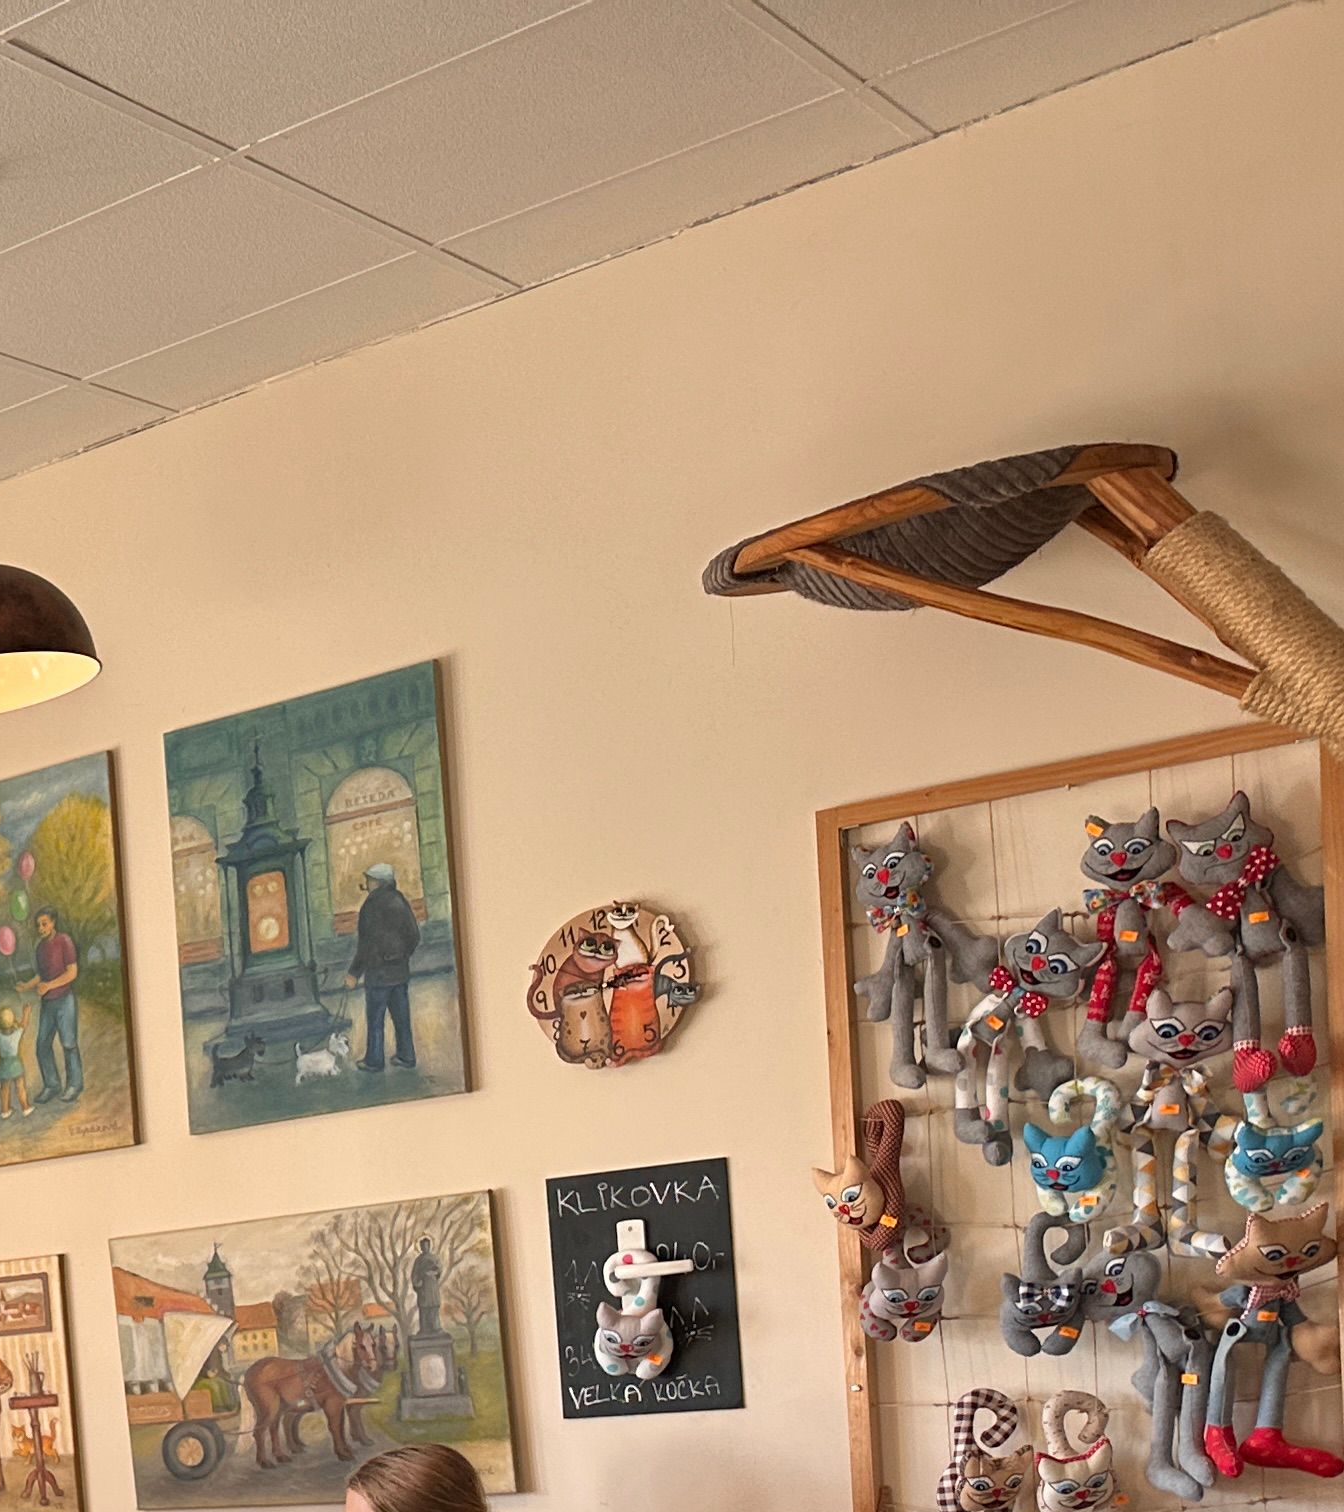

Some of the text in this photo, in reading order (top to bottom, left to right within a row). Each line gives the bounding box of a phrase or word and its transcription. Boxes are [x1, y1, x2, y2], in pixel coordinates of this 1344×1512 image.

[589, 909, 607, 931] 12
[558, 926, 576, 948] 11
[540, 954, 557, 977] 10
[535, 990, 549, 1010] 9
[643, 1023, 657, 1043] 5
[612, 1039, 626, 1056] 6
[651, 1373, 721, 1402] KOČKA
